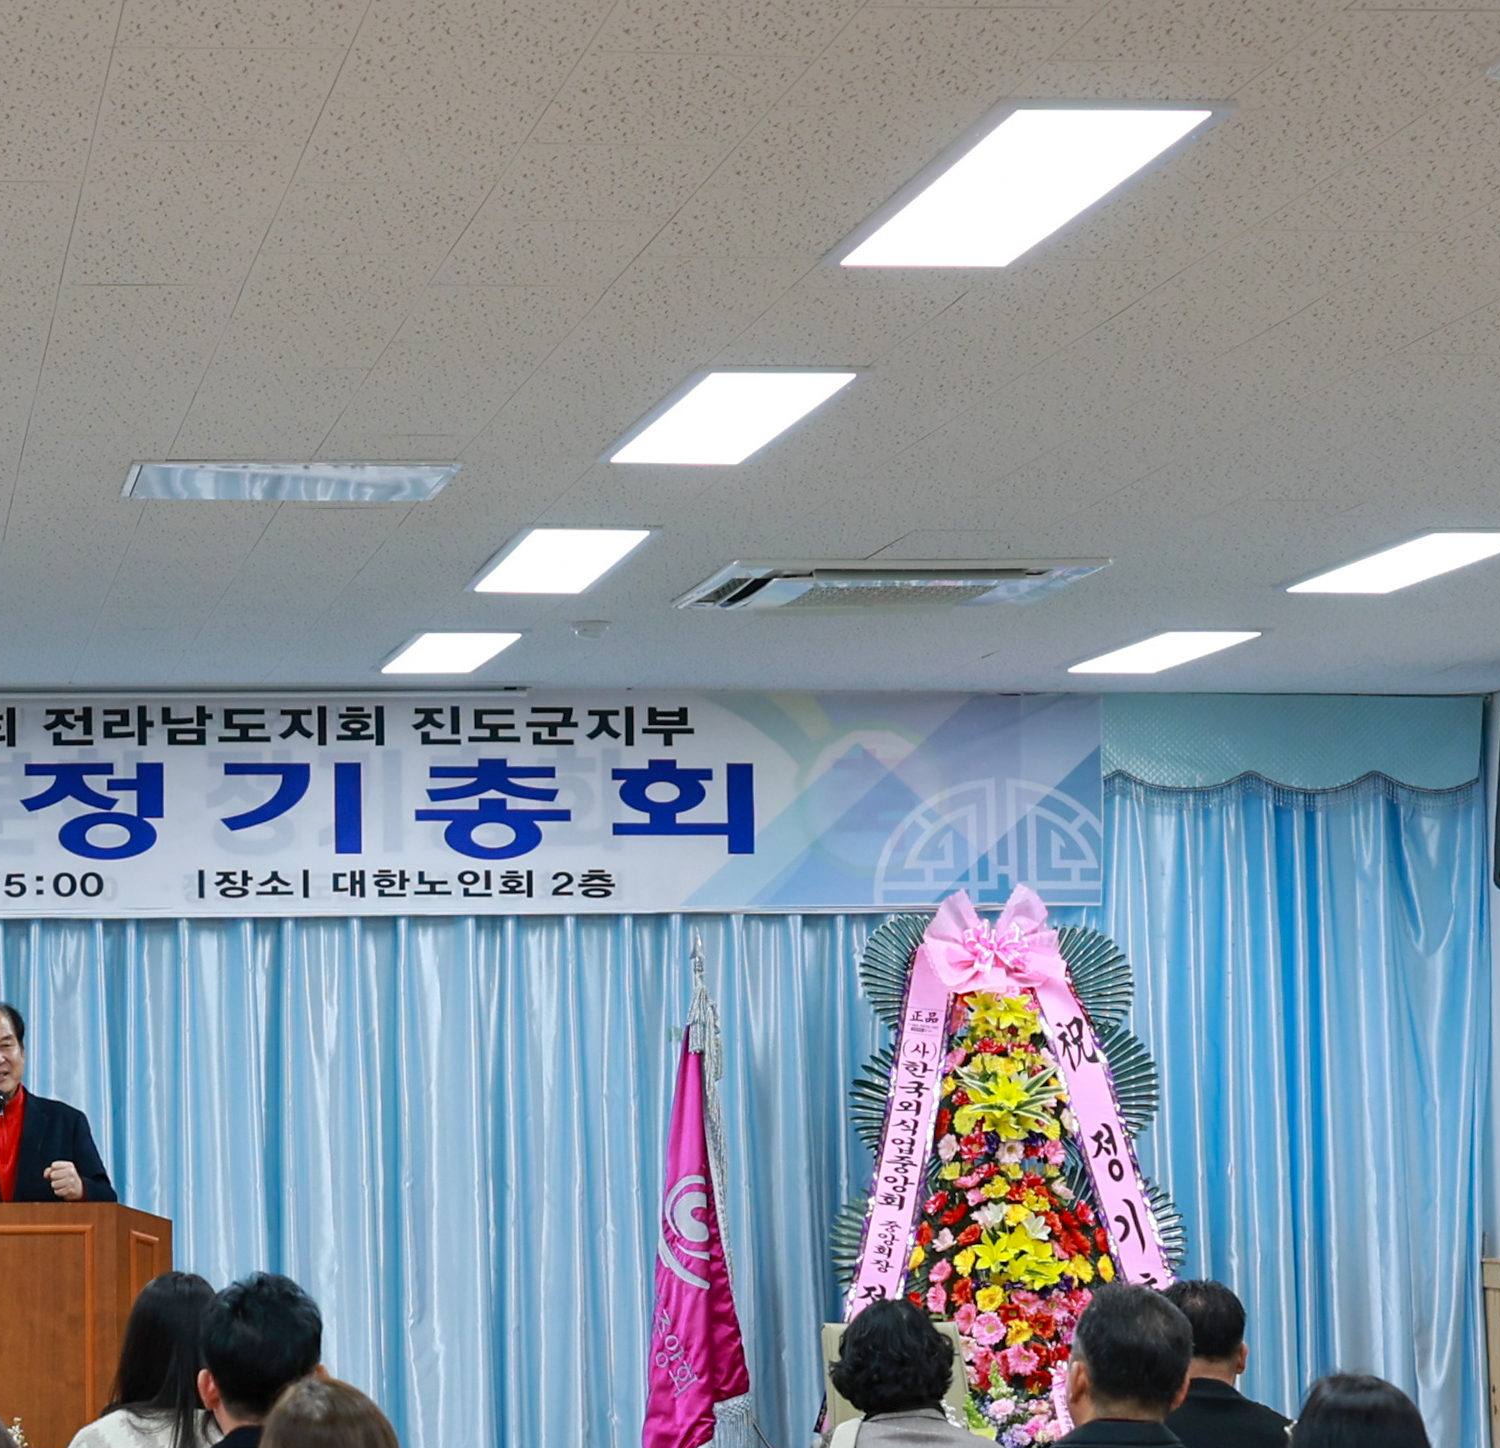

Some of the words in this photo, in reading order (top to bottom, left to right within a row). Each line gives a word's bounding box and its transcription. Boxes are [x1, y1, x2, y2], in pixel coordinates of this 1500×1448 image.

[42, 705, 386, 748] 전라남도지회
[411, 705, 696, 748] 진도군지부
[20, 758, 756, 860] 정기총회
[332, 869, 534, 899] 대한노인회
[551, 869, 616, 899] 2층
[1057, 1015, 1100, 1072] 祝
[878, 1039, 937, 1211] (사)한국외식업중앙회
[1090, 1123, 1157, 1289] 정기
